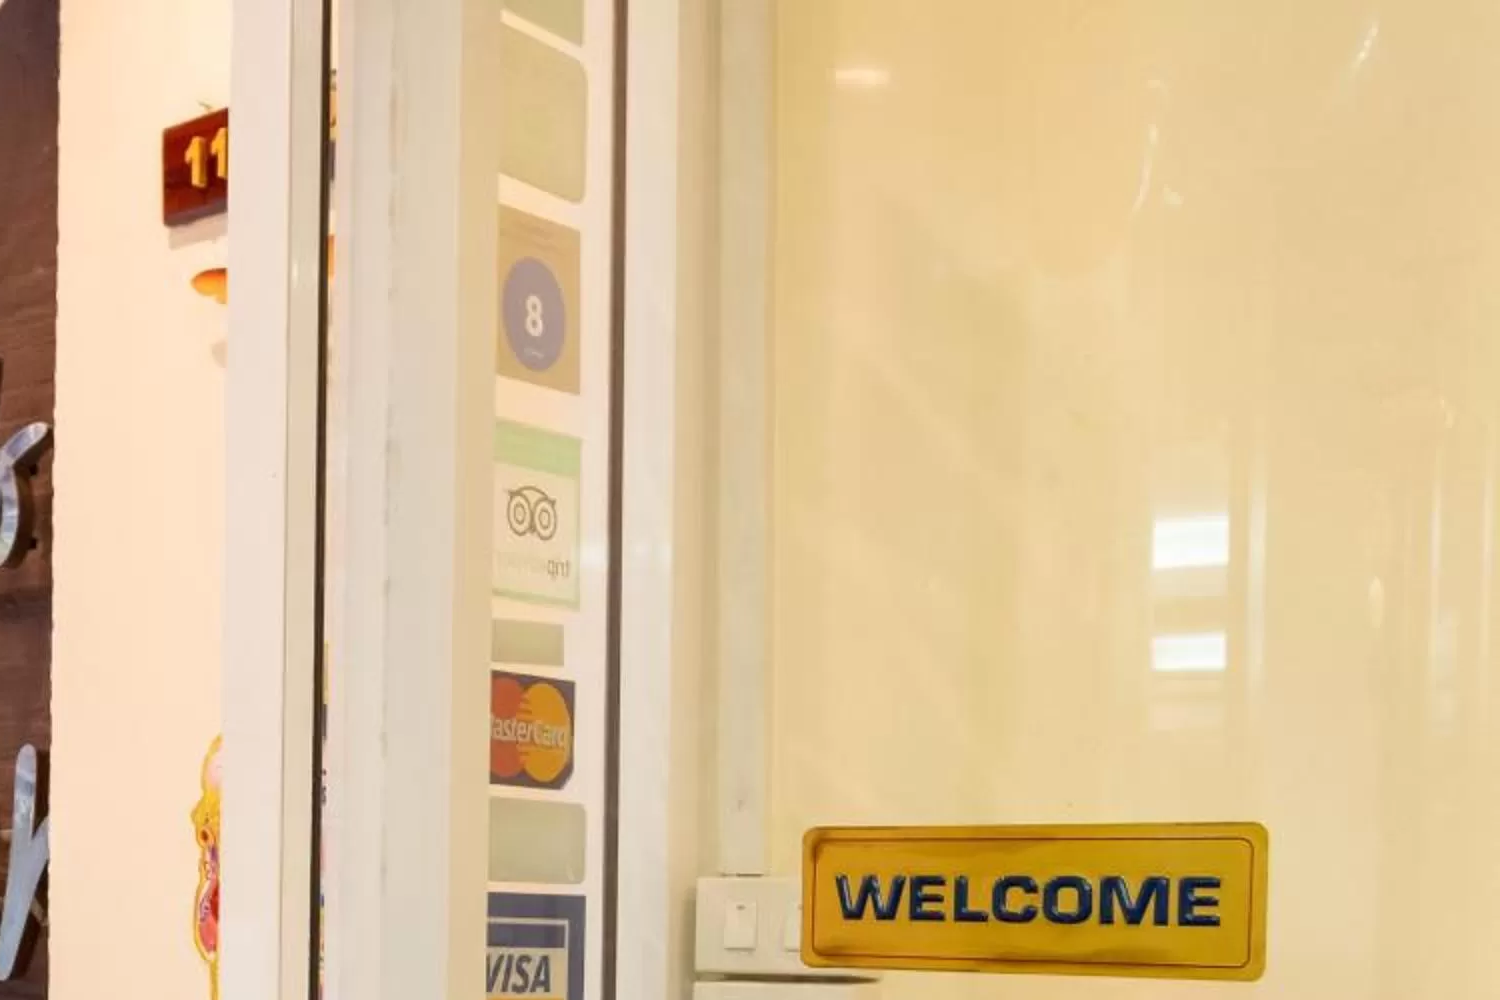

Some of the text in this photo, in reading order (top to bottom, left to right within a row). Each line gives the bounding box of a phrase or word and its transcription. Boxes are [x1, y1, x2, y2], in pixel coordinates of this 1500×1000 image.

[525, 294, 544, 337] 8
[490, 714, 566, 747] asterCard
[835, 873, 1222, 927] WELCOME
